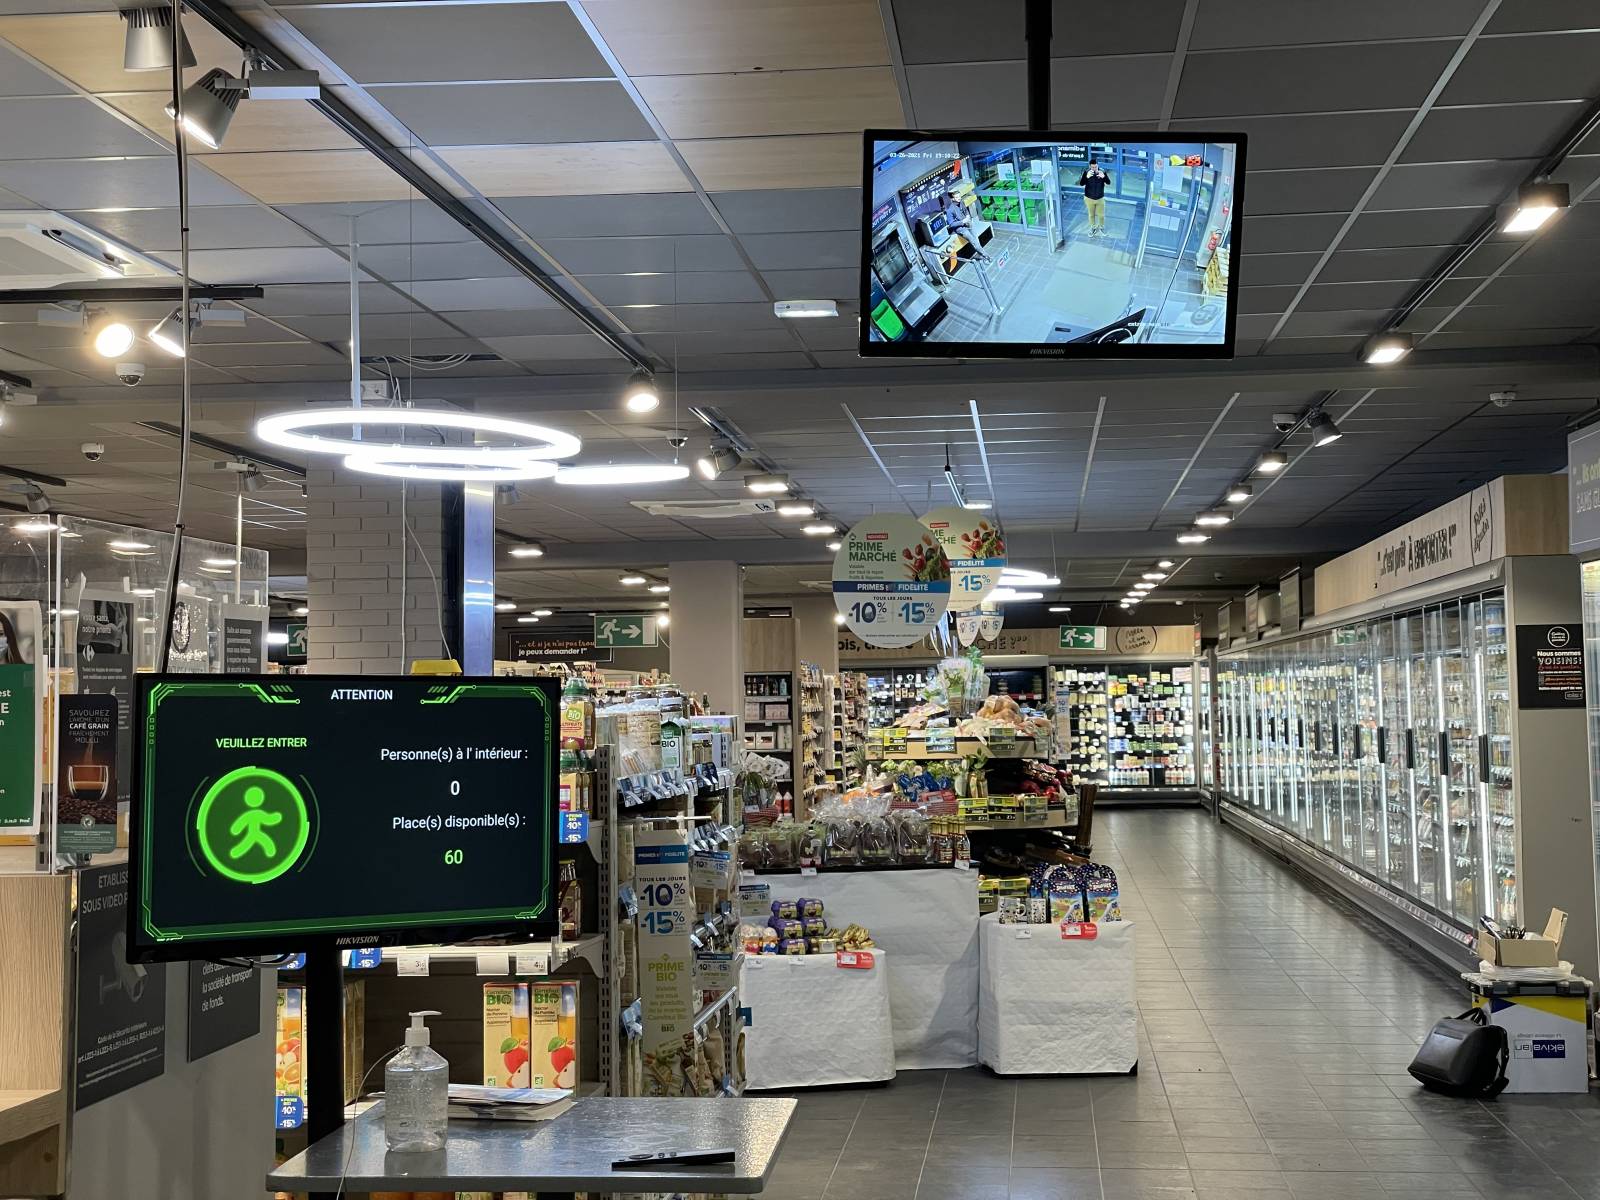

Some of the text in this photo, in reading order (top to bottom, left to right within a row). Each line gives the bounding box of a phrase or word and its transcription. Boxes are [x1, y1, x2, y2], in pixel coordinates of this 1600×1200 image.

[848, 541, 883, 551] PRIME
[848, 550, 897, 562] MARCHÉ
[857, 583, 885, 591] PRIMES
[849, 602, 887, 623] -10%
[898, 602, 936, 624] -15%
[518, 648, 526, 657] je
[526, 649, 543, 657] peux
[331, 689, 393, 701] ATTENTION
[69, 709, 110, 717] SAVOUREZ
[69, 722, 87, 730] CAFÉ
[216, 737, 308, 749] VEUILLEZ ENTRER
[661, 740, 676, 748] BIO
[380, 747, 453, 763] Personne(s)
[456, 747, 464, 760] à
[475, 747, 523, 760] intérieur
[450, 780, 461, 796] 0
[392, 815, 442, 831] Place(s)
[444, 813, 520, 830] disponible(s)
[444, 849, 464, 865] 60
[640, 883, 686, 907] -10%
[82, 898, 101, 914] SOUS
[102, 893, 123, 909] VIDEO
[641, 911, 686, 934] -15%
[336, 936, 380, 945] HIKVISION
[648, 961, 685, 972] PRIME
[225, 973, 232, 986] de
[656, 972, 677, 982] BIO
[486, 994, 512, 1005] BIO
[534, 993, 560, 1004] BIO
[202, 1001, 209, 1012] de
